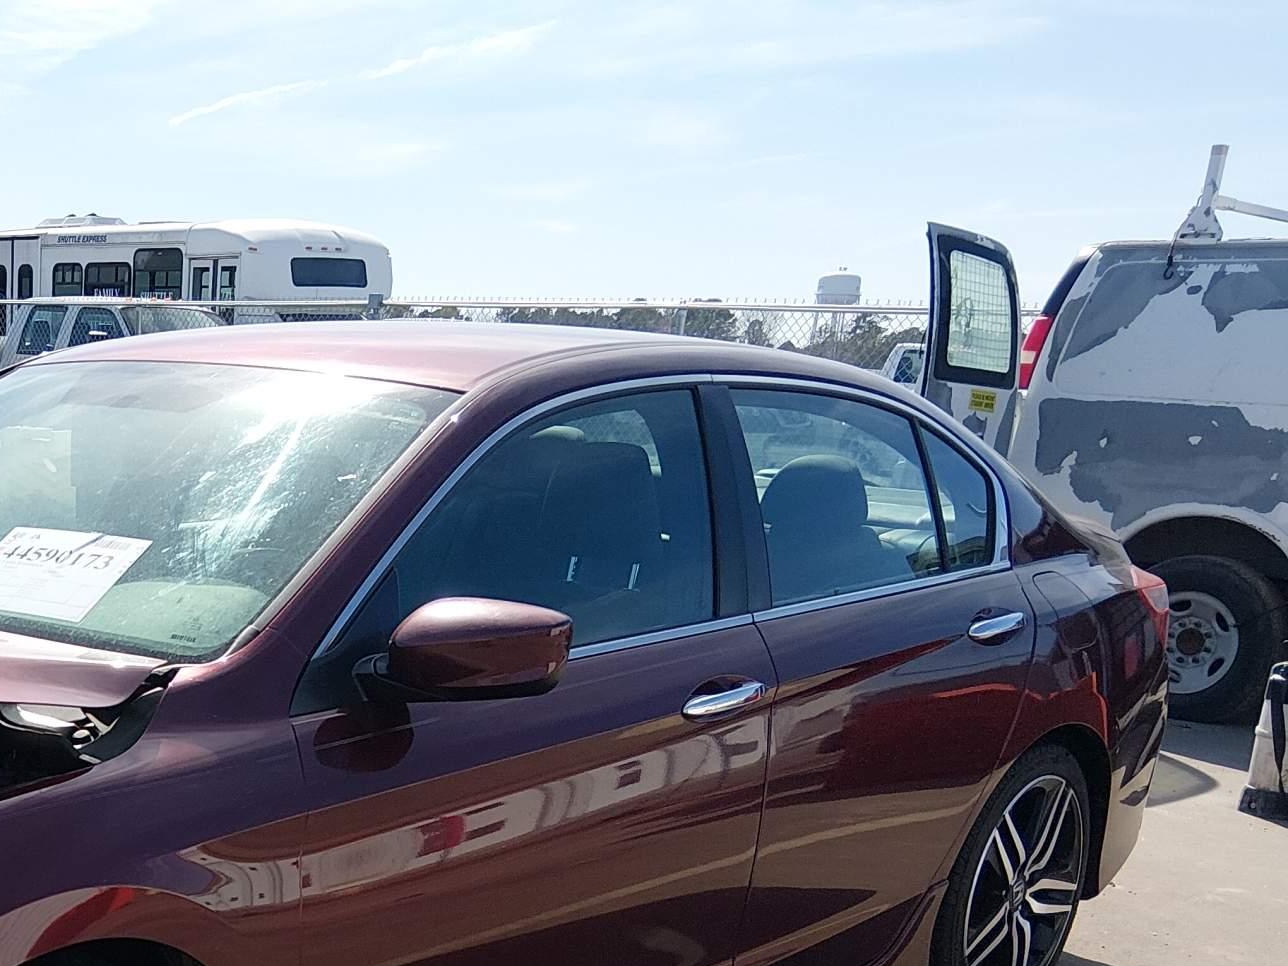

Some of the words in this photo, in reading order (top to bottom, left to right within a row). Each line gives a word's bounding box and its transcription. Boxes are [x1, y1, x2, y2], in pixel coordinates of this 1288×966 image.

[57, 235, 81, 243] SHUTTLE
[82, 235, 107, 243] EXPRESS
[93, 287, 120, 297] FAMILY
[3, 545, 114, 570] 44590173
